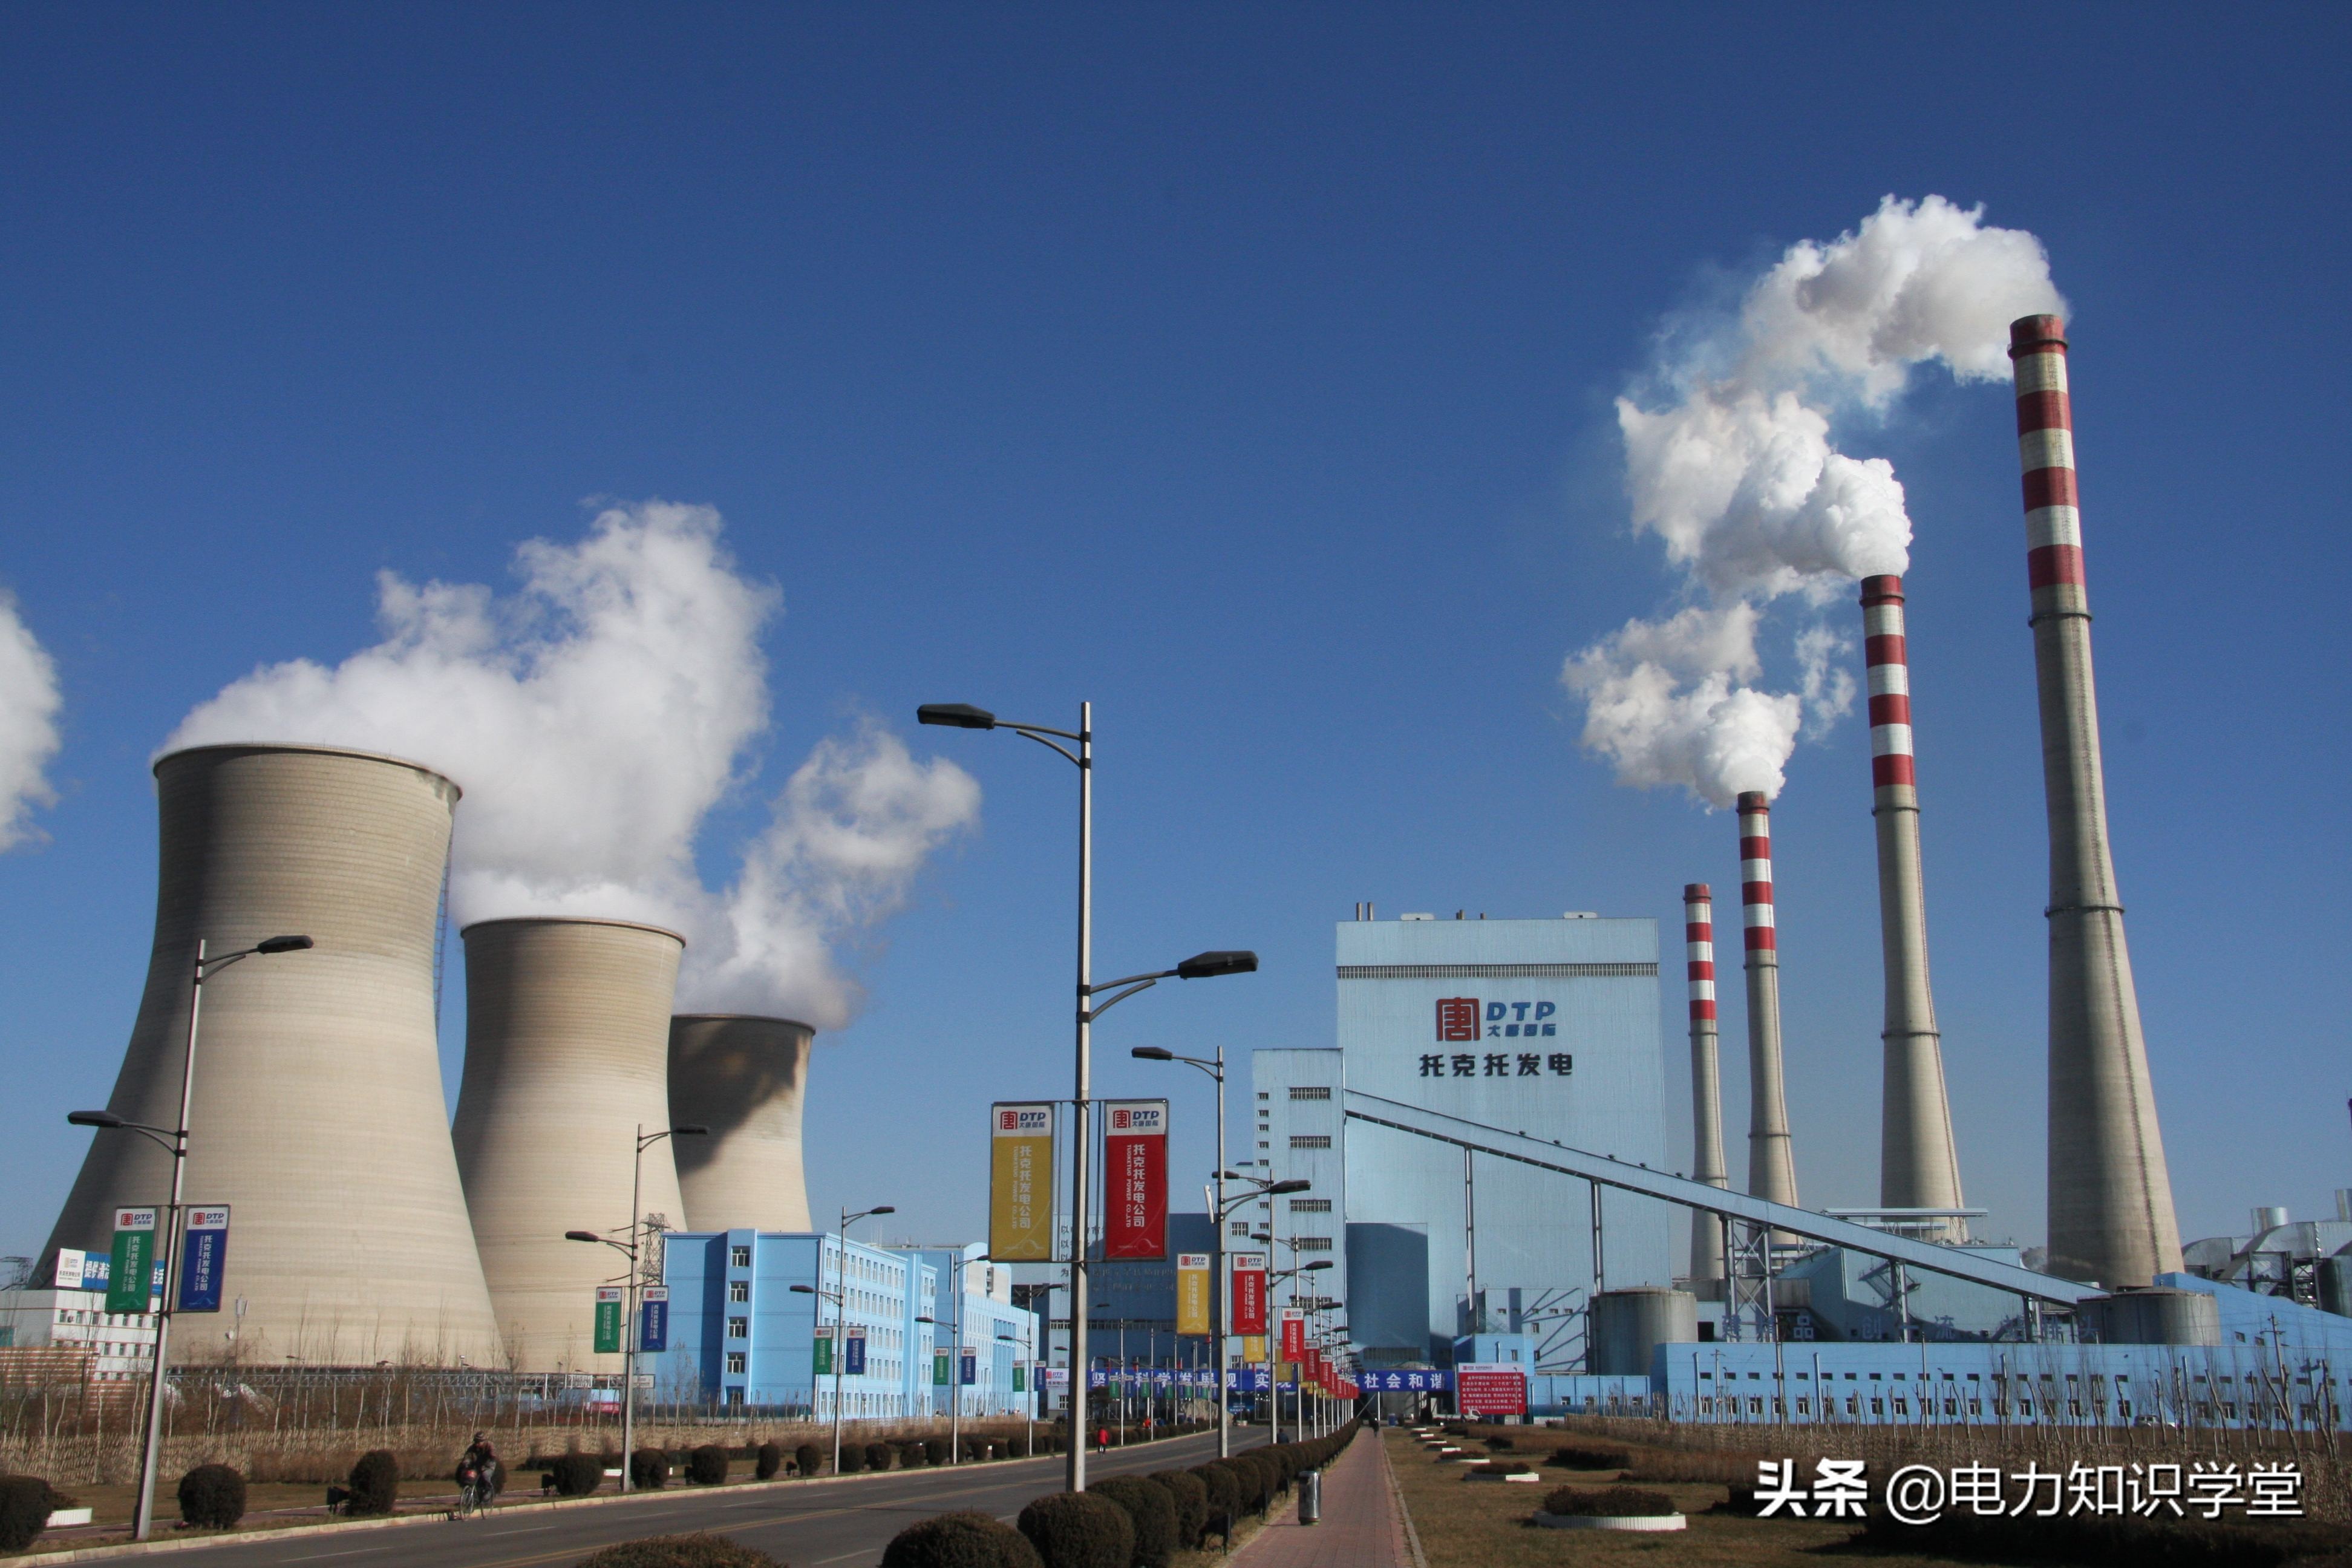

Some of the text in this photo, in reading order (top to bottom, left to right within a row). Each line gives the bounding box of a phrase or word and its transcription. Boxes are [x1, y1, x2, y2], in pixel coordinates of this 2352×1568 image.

[1486, 1002, 1556, 1021] DTP
[1488, 1024, 1557, 1037] 大唐国际
[1419, 1053, 1572, 1077] 托克托发电
[1020, 1112, 1047, 1121] DTP
[1132, 1111, 1160, 1120] DTP
[1019, 1145, 1032, 1229] 托克托发电公司
[1133, 1144, 1145, 1227] 托克托发电公司
